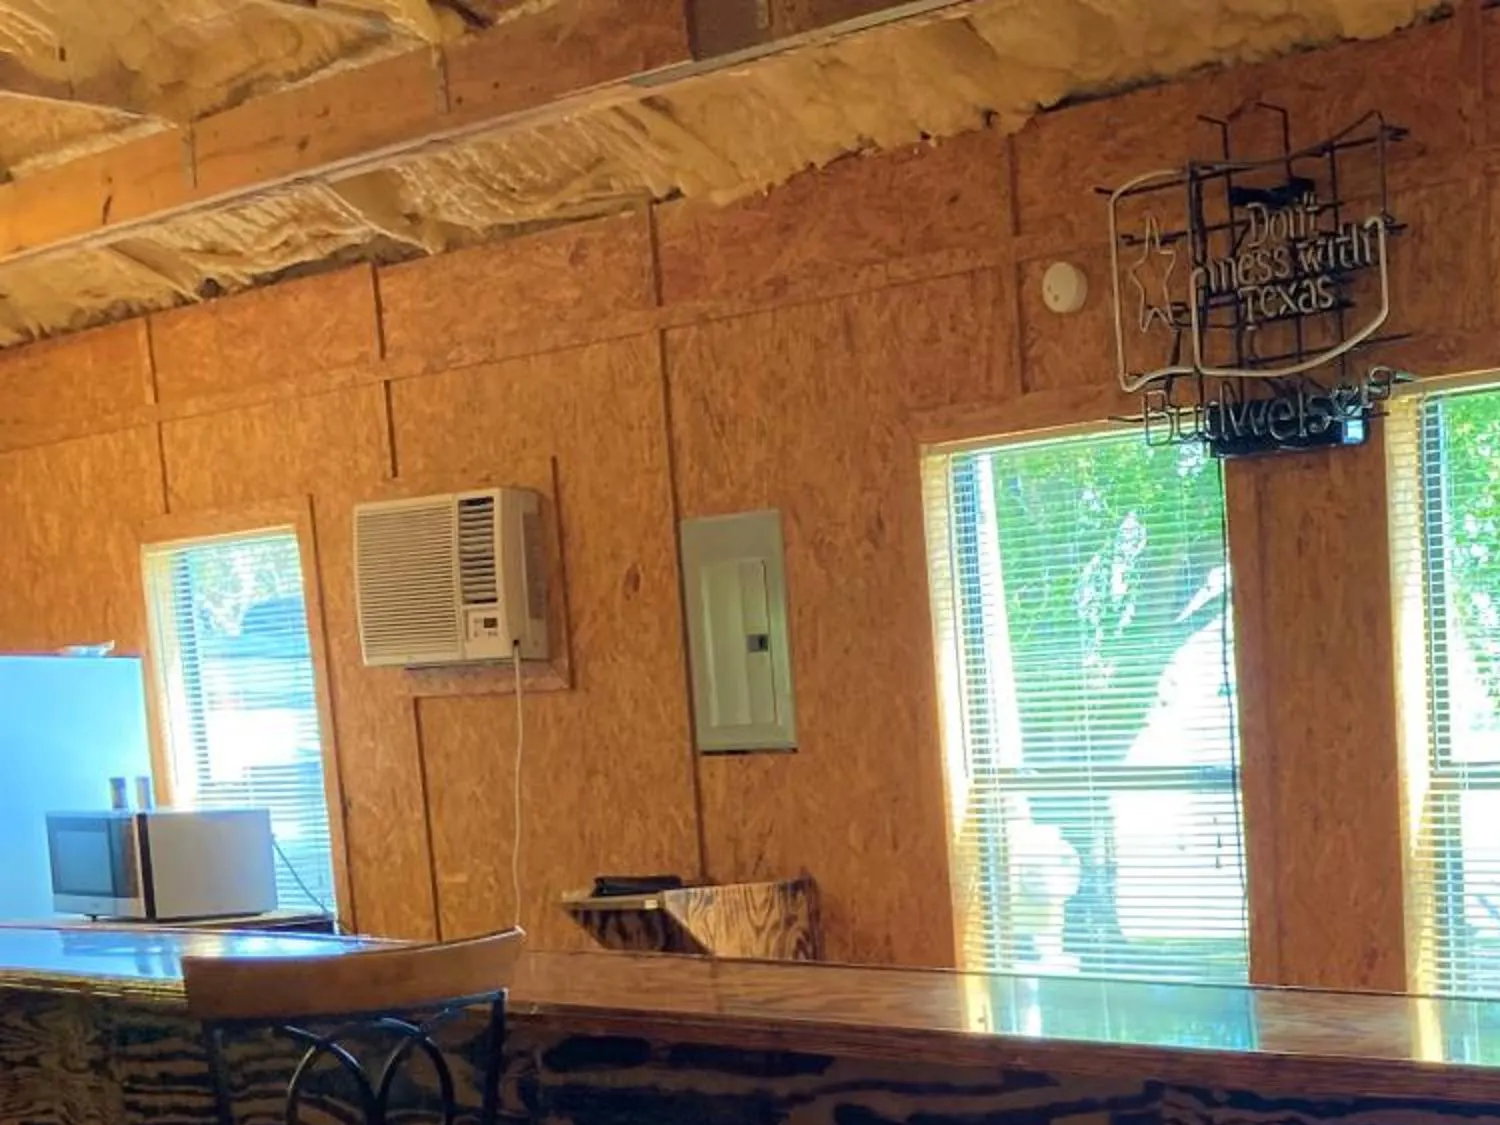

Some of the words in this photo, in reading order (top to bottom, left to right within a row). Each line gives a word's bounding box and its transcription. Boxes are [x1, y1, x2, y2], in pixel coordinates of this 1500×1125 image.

[1206, 247, 1290, 293] mess
[1295, 222, 1374, 272] with
[1237, 275, 1334, 331] Texas
